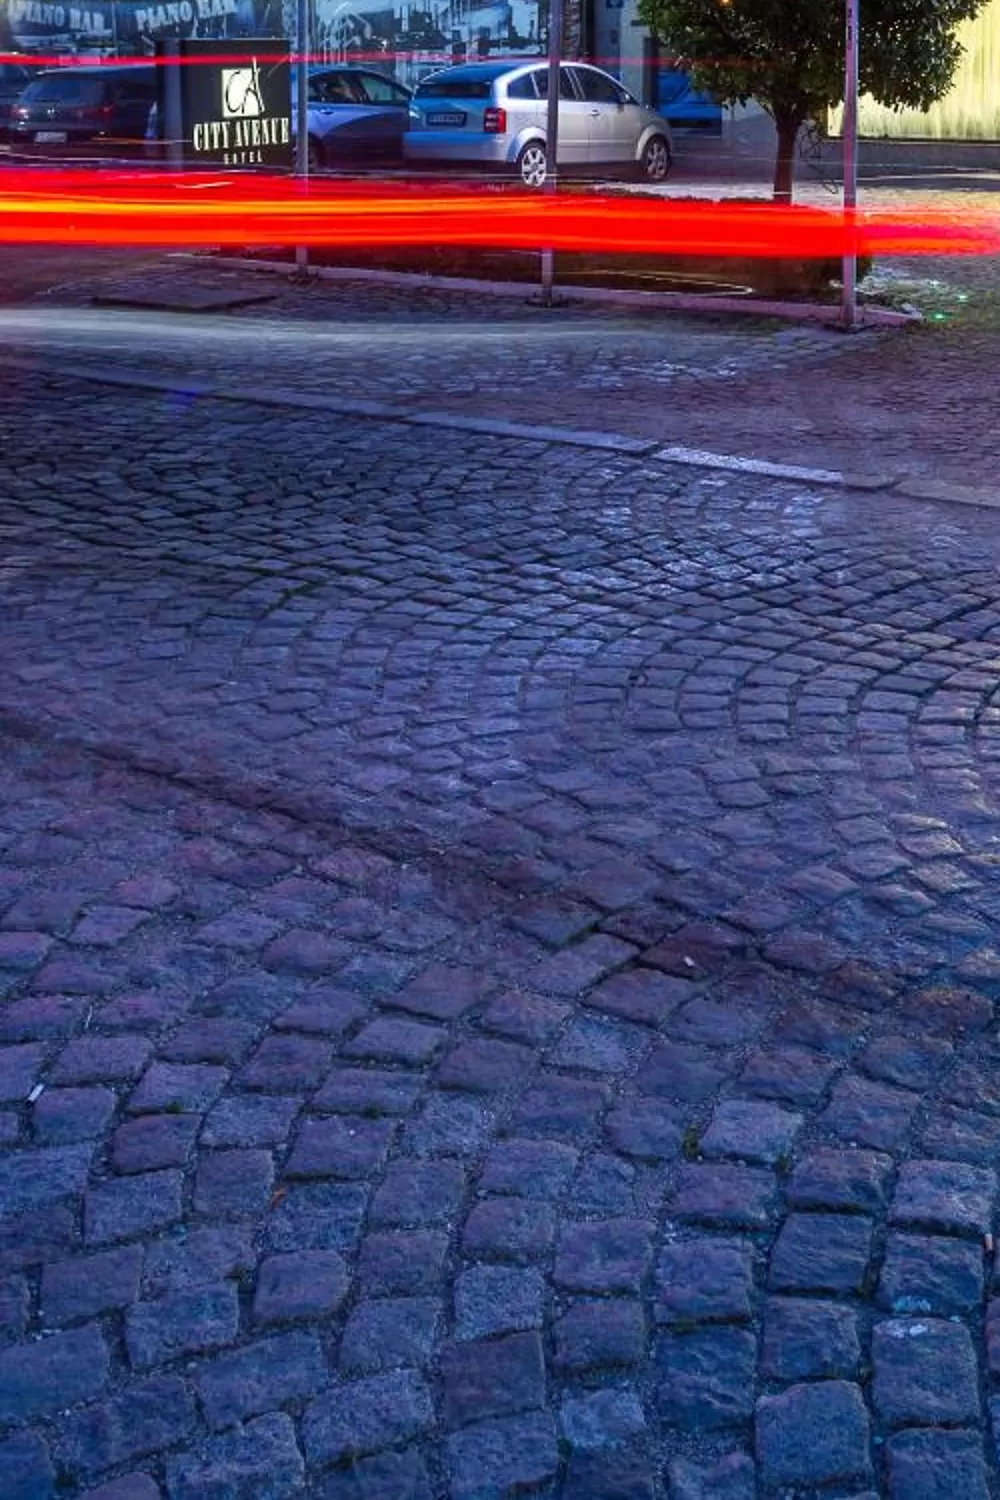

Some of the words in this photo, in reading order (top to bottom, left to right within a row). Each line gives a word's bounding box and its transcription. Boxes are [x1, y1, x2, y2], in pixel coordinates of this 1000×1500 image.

[134, 0, 193, 32] PIANO
[193, 120, 231, 151] CITY
[234, 116, 289, 147] AVENUE
